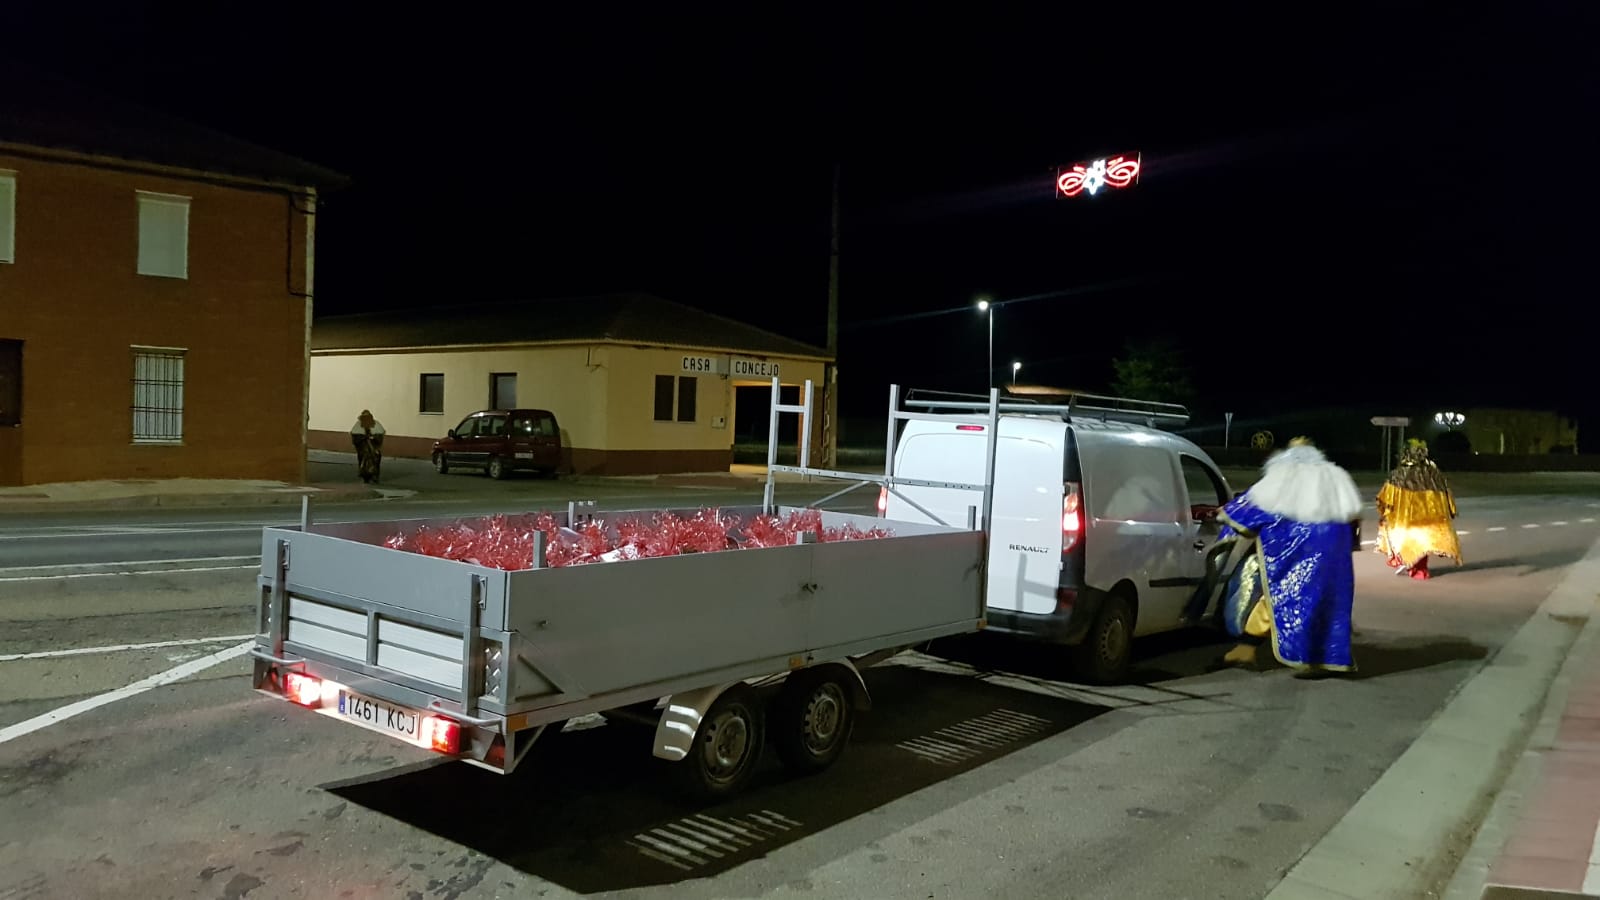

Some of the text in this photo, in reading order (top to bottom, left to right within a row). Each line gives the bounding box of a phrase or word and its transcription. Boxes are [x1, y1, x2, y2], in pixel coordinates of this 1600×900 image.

[683, 357, 779, 376] CASA CONCEJO
[1009, 543, 1050, 553] RENAULT
[348, 695, 415, 735] 1461 KCJ
